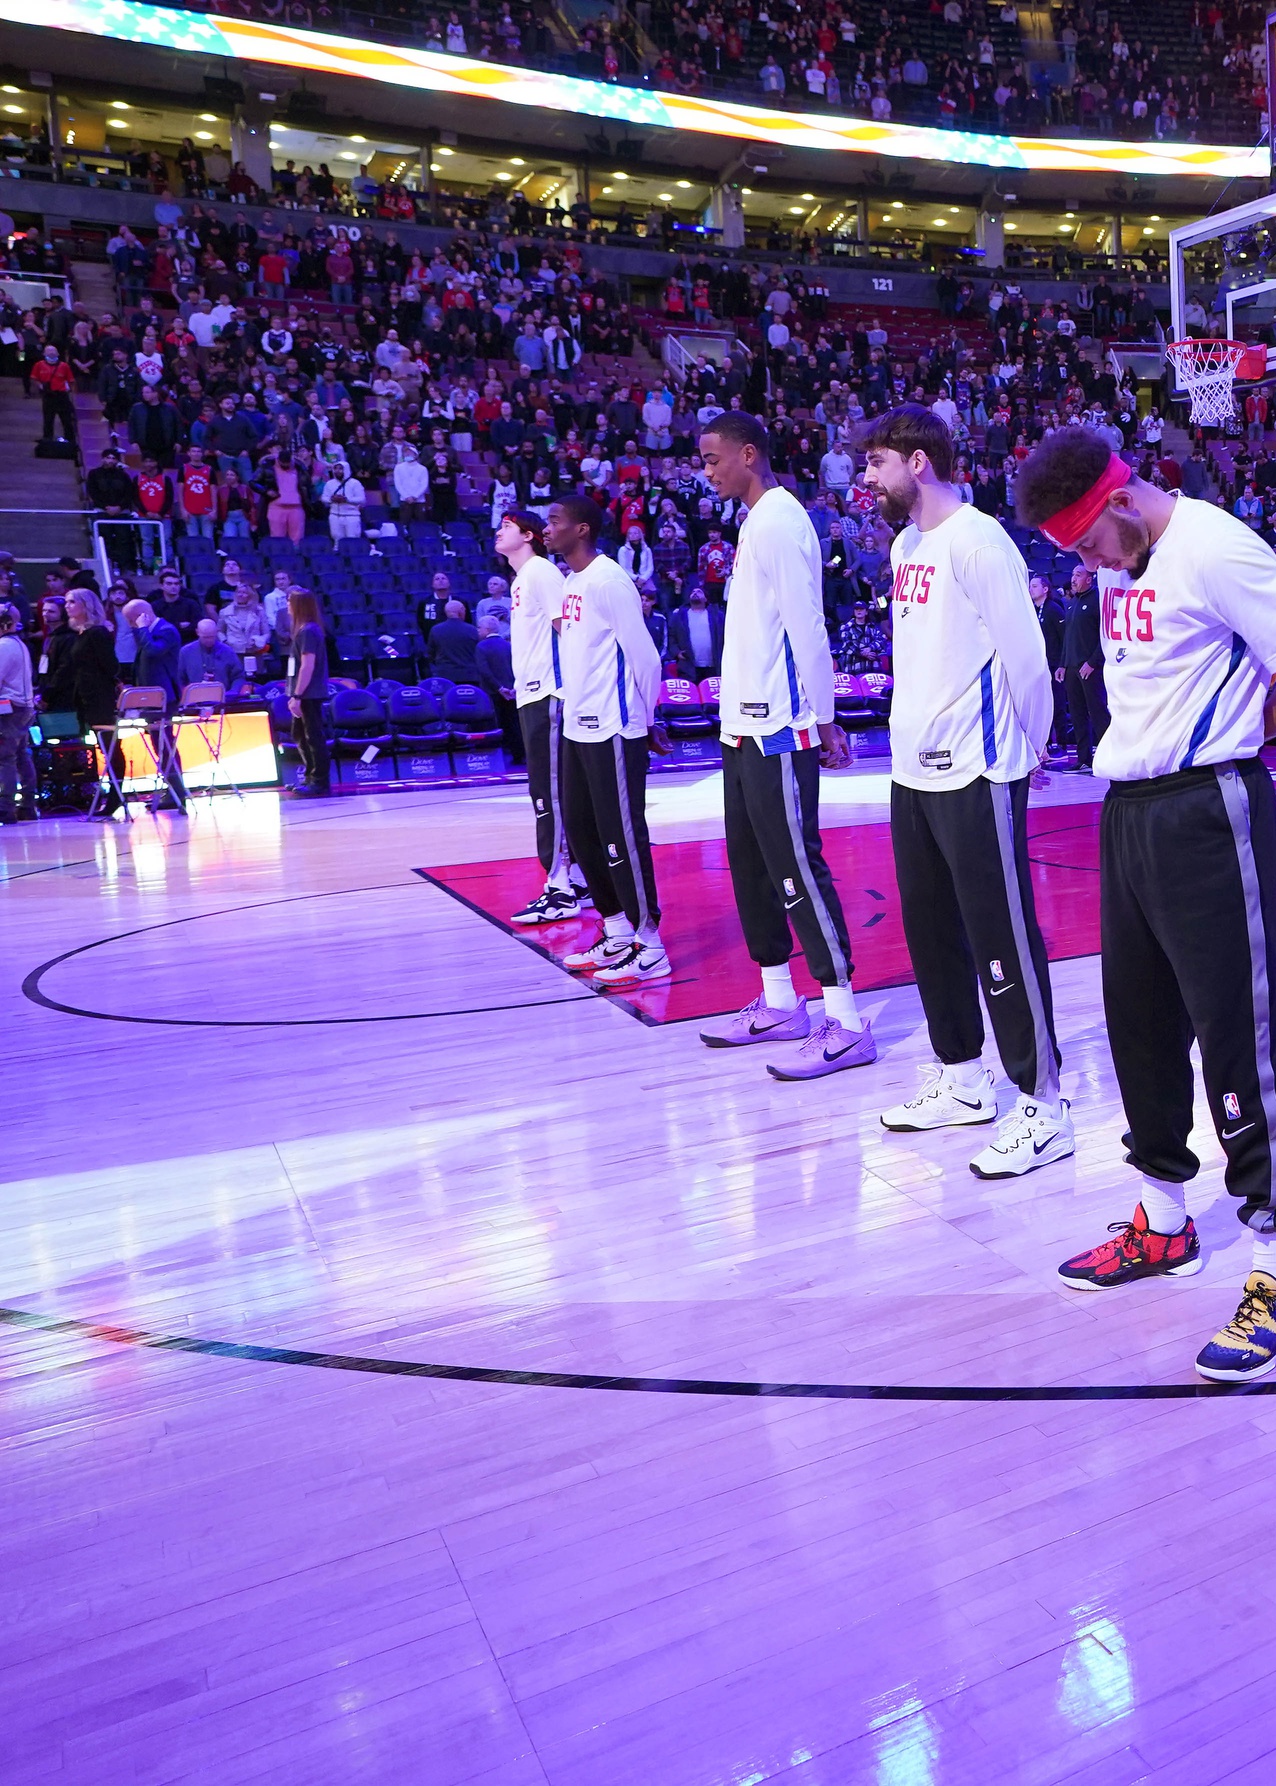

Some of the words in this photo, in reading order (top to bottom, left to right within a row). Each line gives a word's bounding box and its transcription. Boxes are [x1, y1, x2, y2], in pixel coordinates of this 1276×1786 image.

[328, 224, 361, 242] 10
[872, 278, 894, 291] 121
[149, 487, 155, 496] 2
[190, 483, 204, 494] 43
[892, 563, 935, 604] NETS
[562, 594, 583, 621] ETS
[1102, 587, 1155, 642] NETS
[665, 680, 690, 688] BIO
[865, 674, 887, 682] BIO
